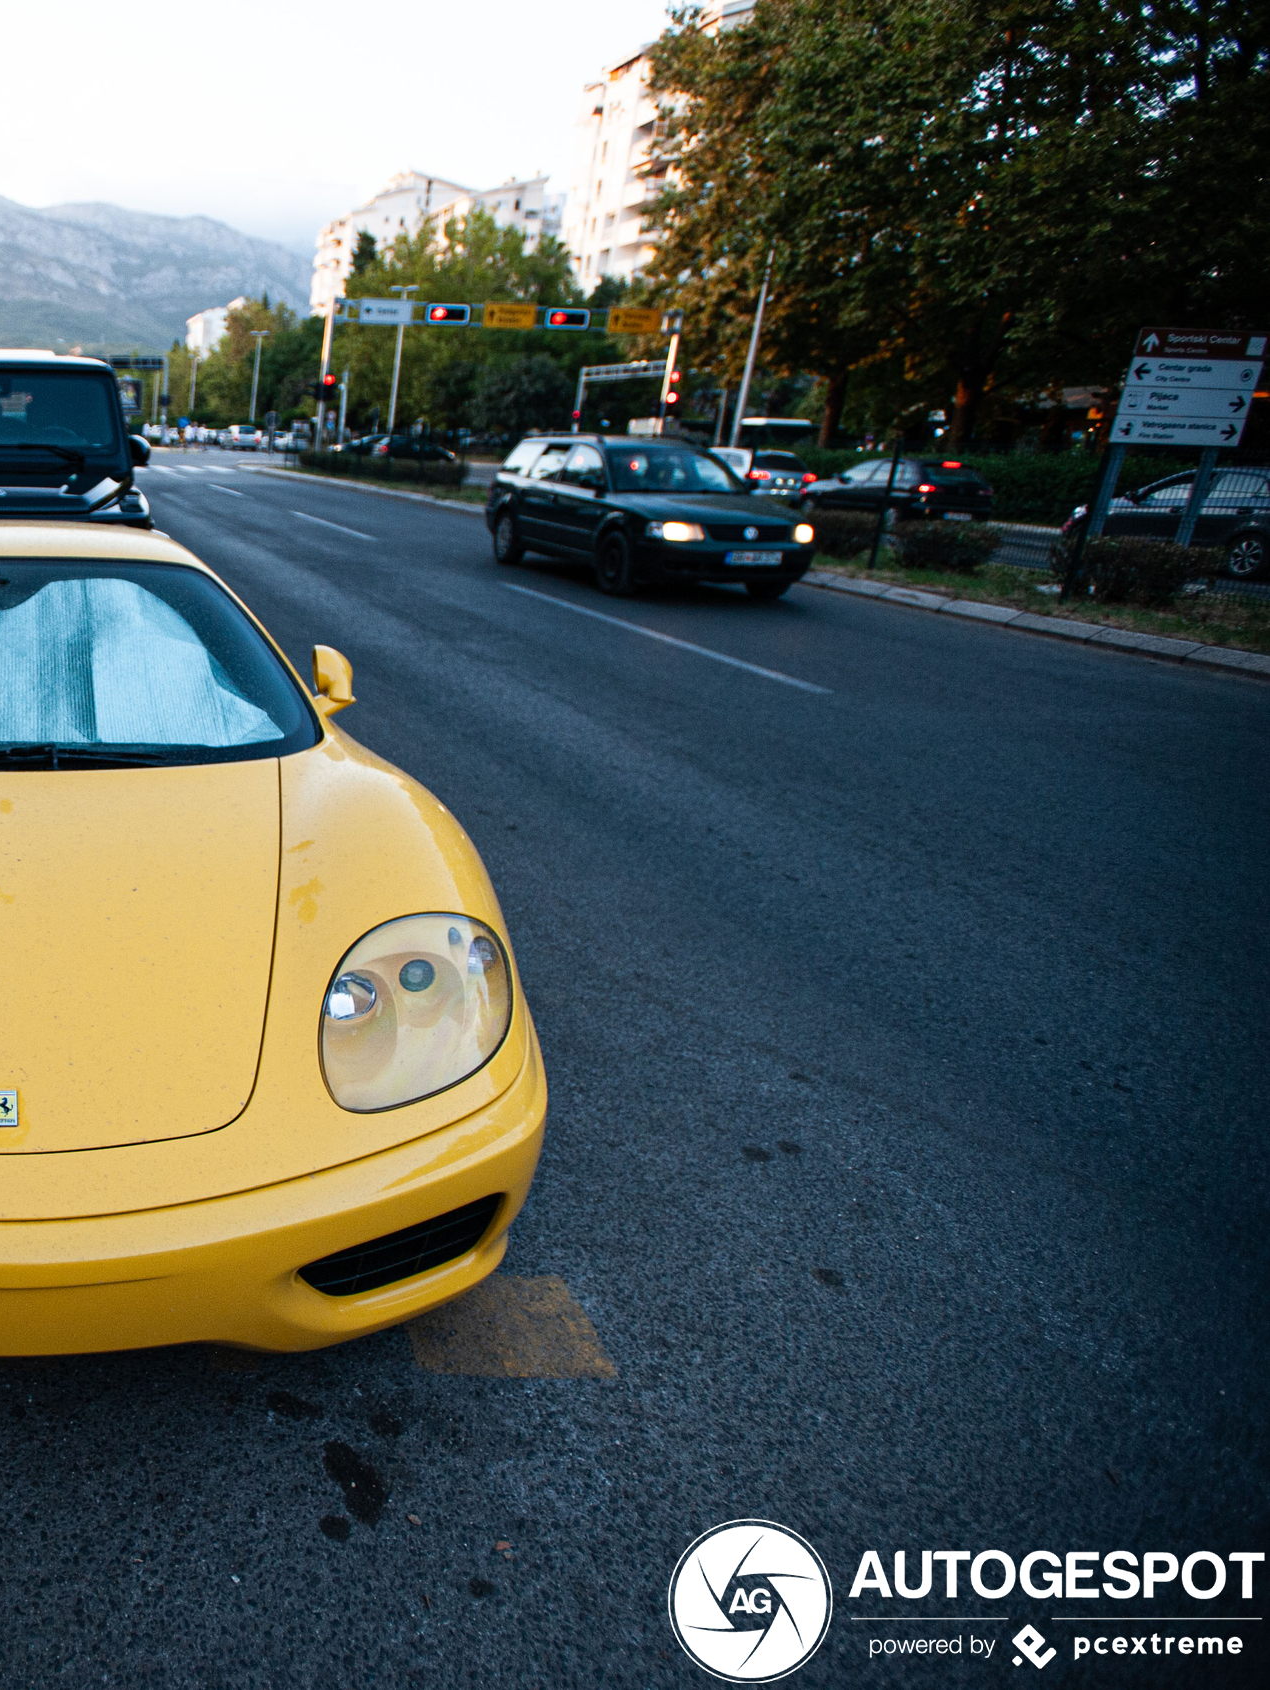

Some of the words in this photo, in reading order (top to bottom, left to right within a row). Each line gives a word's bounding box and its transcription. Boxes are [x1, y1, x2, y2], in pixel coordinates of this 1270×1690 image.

[1167, 333, 1208, 343] Sportski
[1149, 392, 1179, 401] Pijaca
[1142, 421, 1186, 430] Vatrogasna
